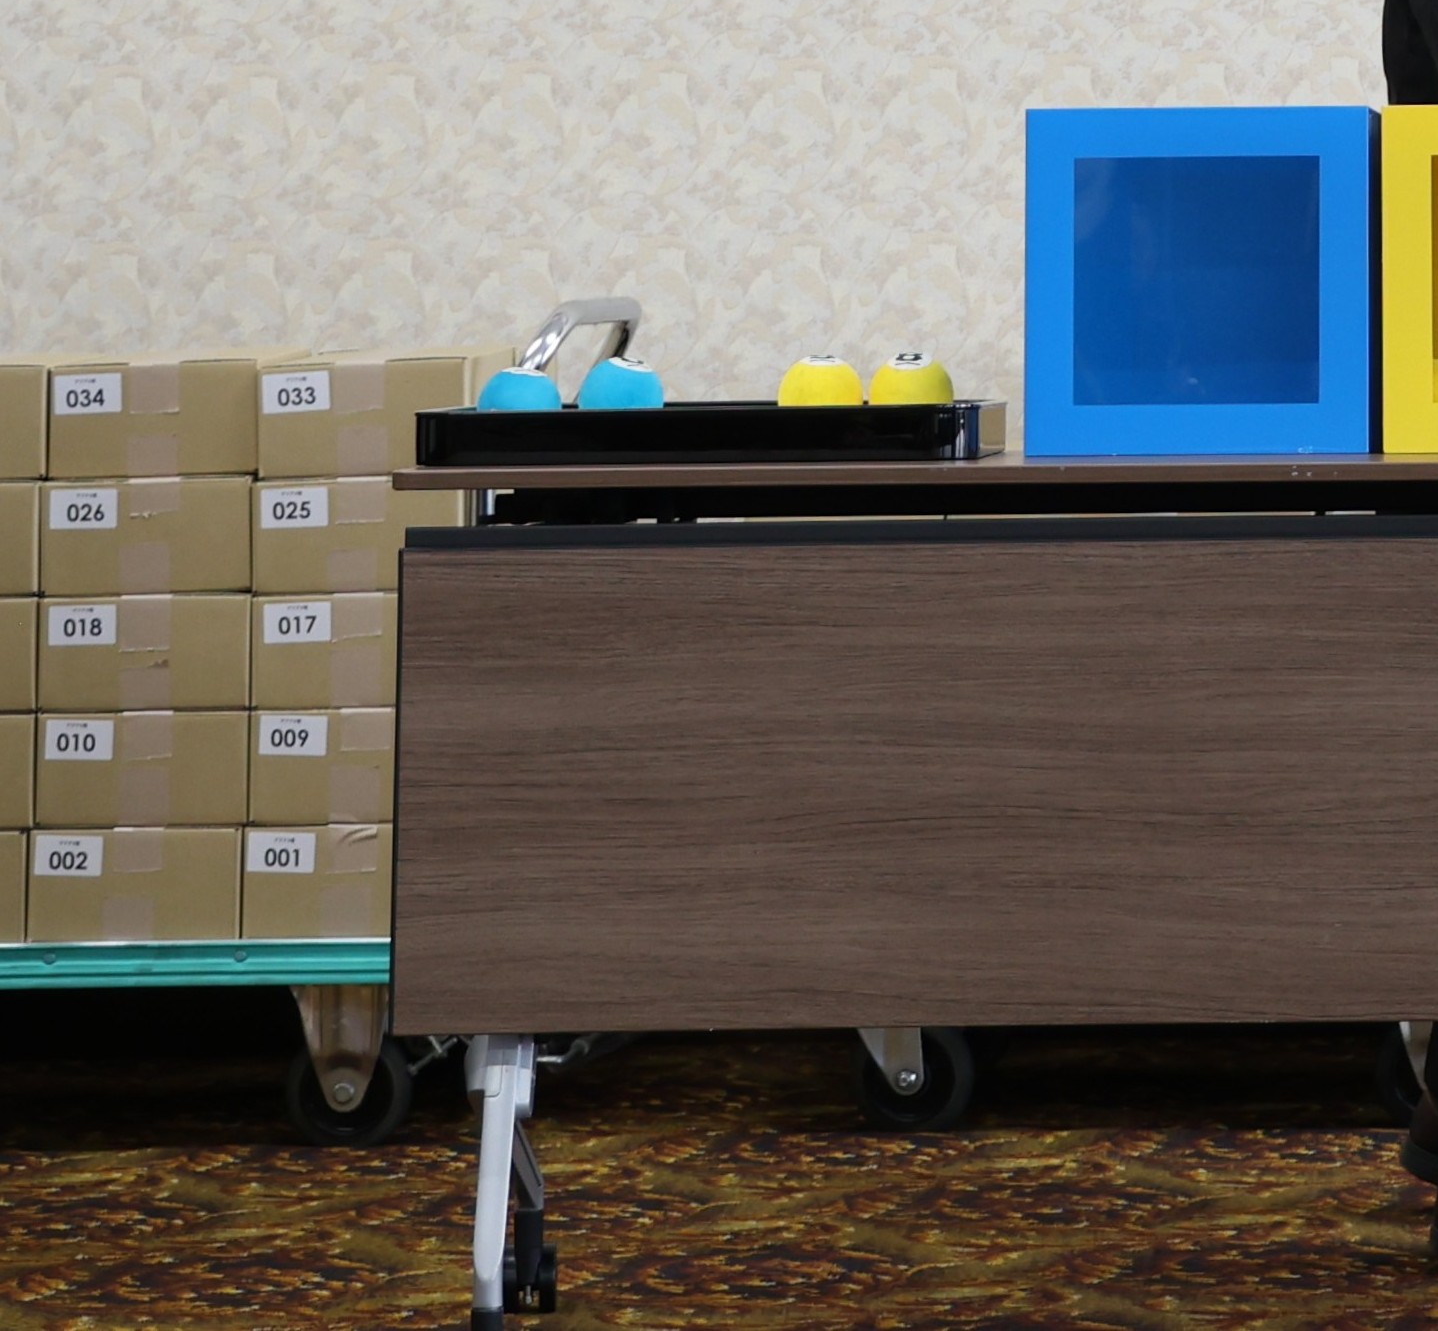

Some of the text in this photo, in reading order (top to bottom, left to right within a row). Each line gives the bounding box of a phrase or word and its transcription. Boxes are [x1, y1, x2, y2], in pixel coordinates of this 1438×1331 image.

[66, 389, 105, 408] 034
[277, 386, 316, 406] 033
[66, 503, 105, 522] 026
[272, 501, 311, 520] 025
[63, 618, 103, 637] 018
[278, 615, 317, 635] 017
[56, 733, 96, 752] 010
[270, 729, 309, 748] 009
[49, 851, 88, 870] 002
[264, 848, 300, 867] 001
